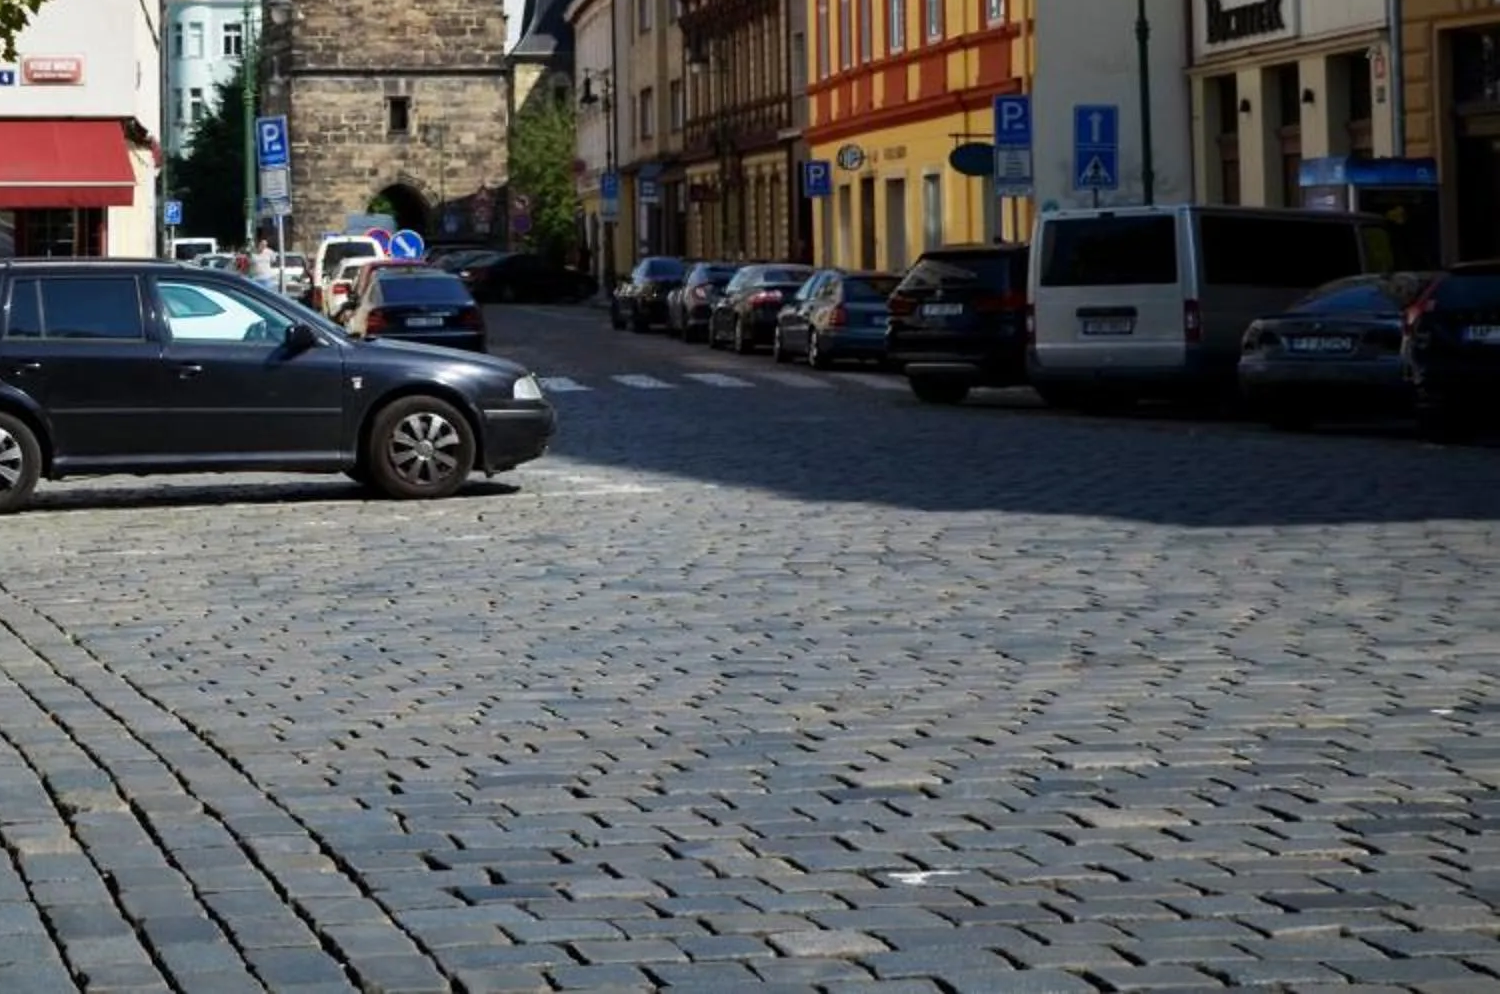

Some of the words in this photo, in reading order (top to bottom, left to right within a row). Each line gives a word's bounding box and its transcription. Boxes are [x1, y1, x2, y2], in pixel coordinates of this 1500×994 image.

[1002, 101, 1024, 130] P
[263, 124, 279, 153] P
[810, 165, 825, 185] P
